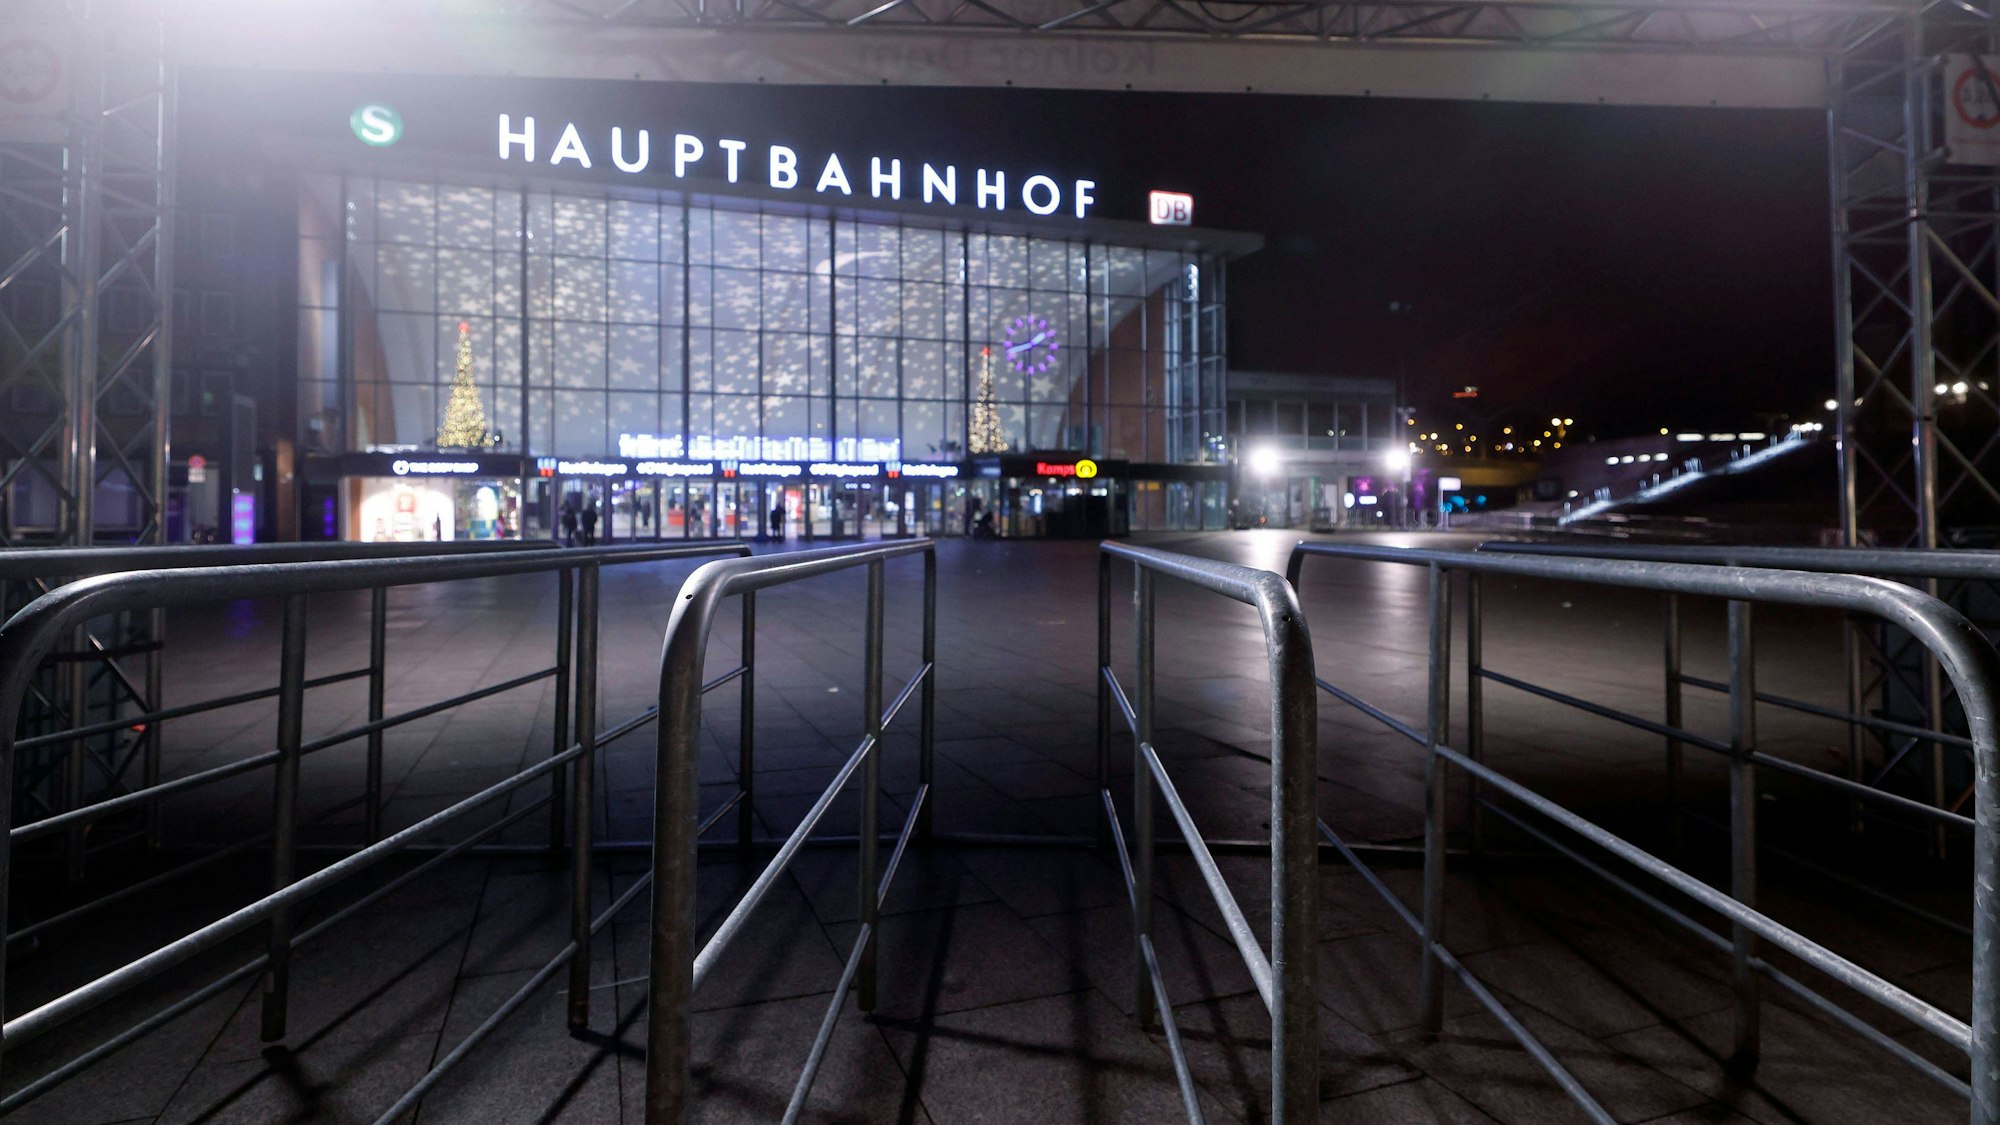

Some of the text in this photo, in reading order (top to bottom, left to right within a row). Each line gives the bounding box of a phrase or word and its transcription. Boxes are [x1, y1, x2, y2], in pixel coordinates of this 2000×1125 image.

[361, 105, 395, 142] S
[499, 113, 1095, 219] HAUPTBAHNHOF
[1157, 199, 1186, 221] DB
